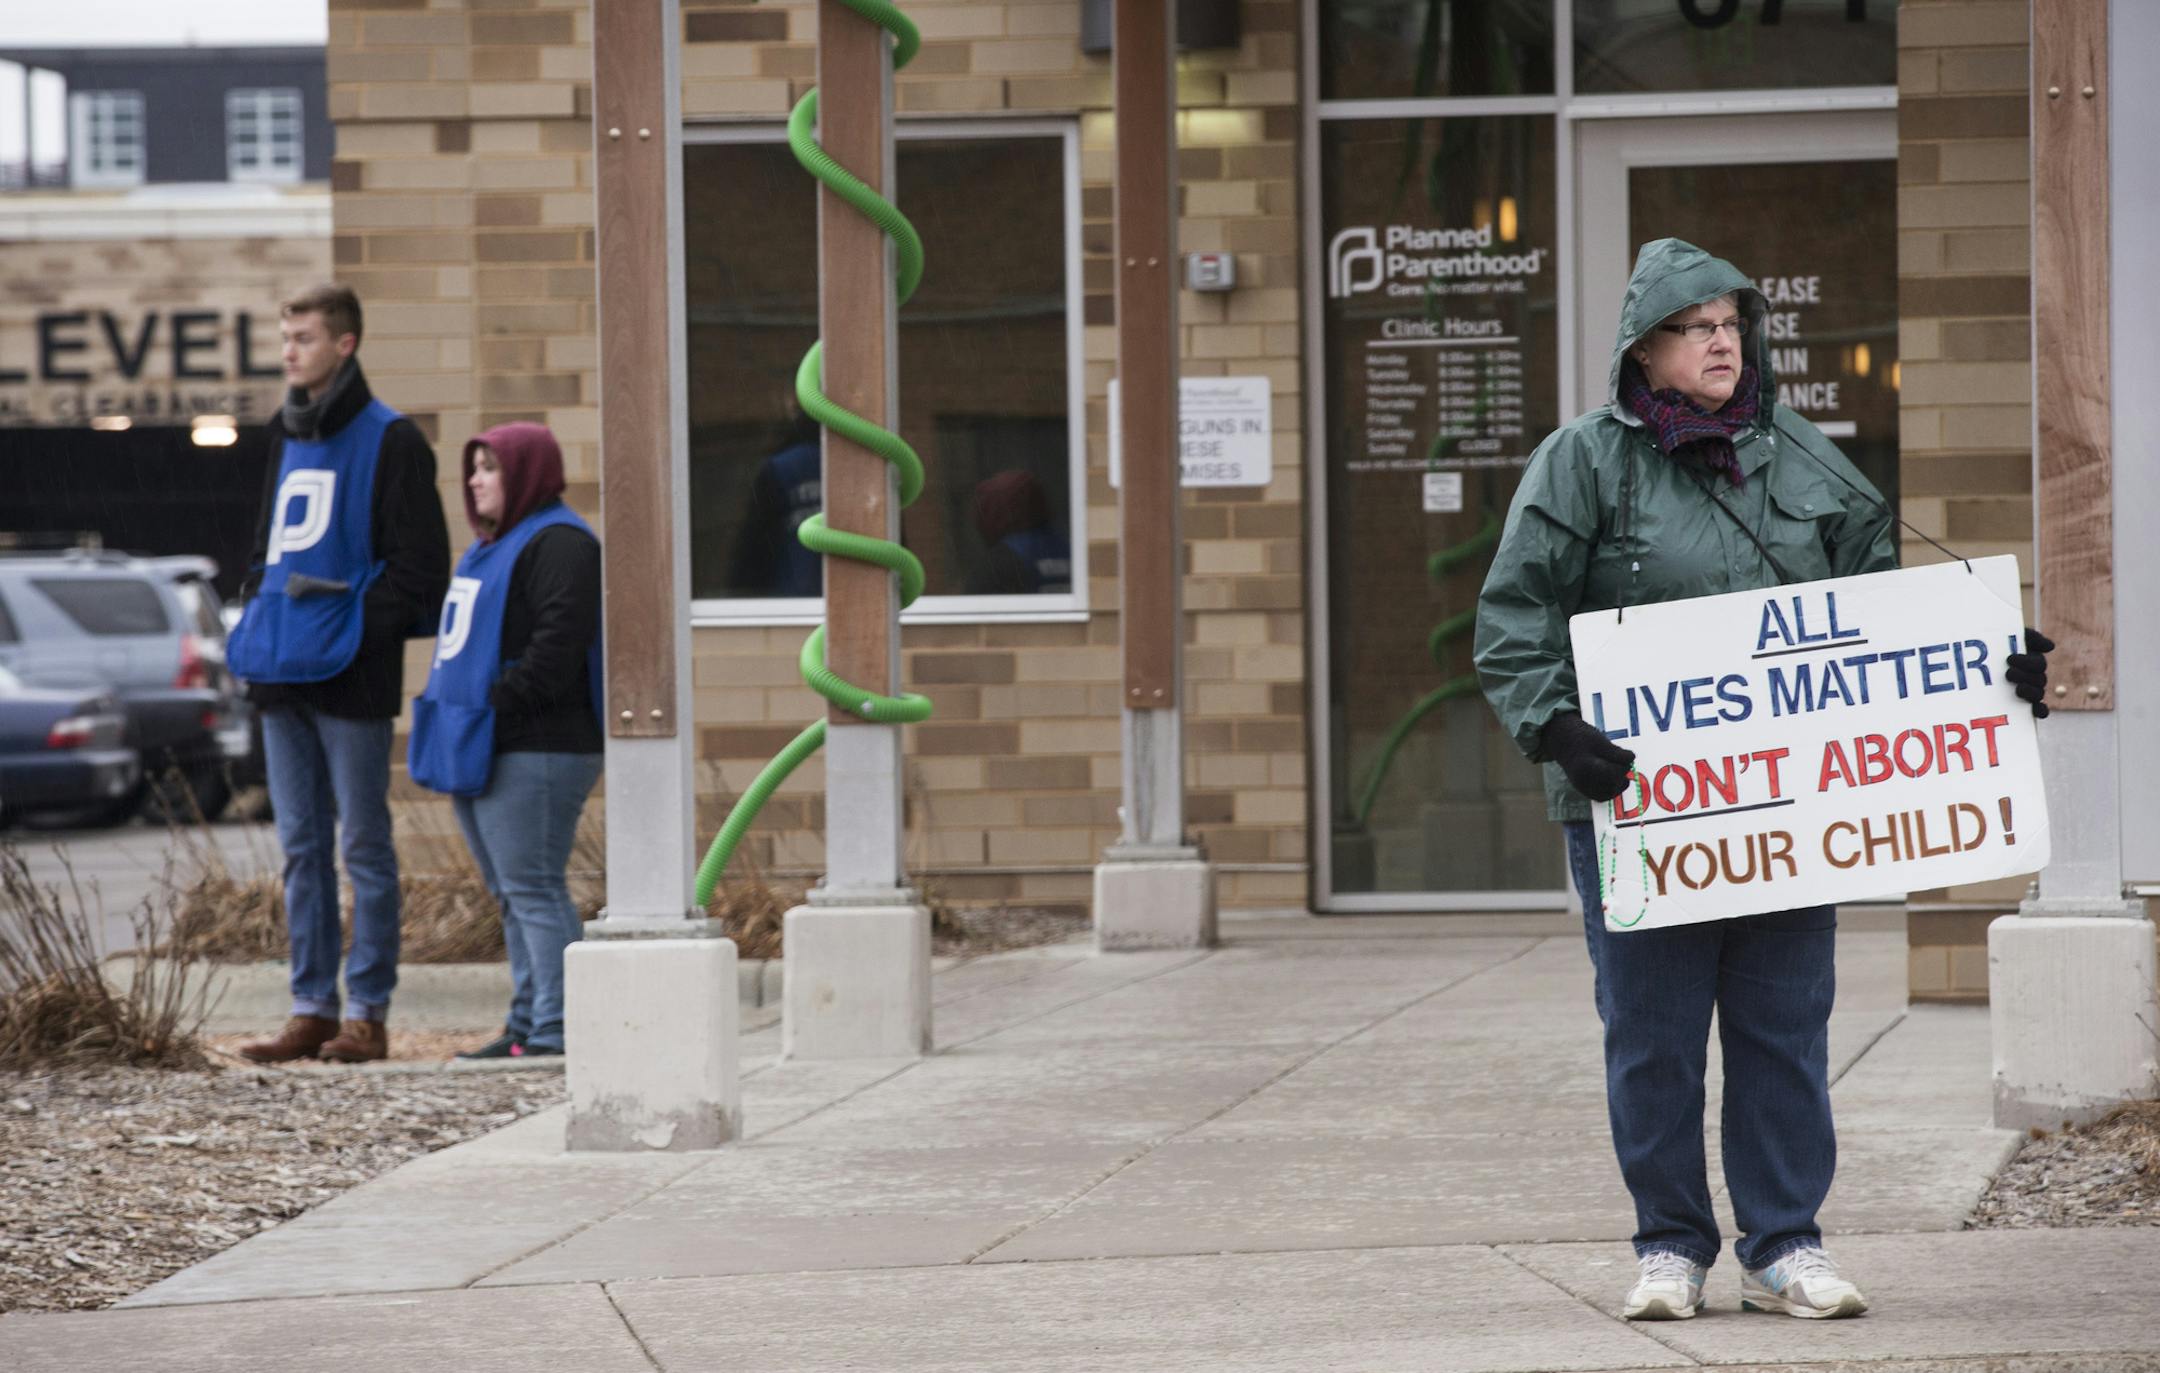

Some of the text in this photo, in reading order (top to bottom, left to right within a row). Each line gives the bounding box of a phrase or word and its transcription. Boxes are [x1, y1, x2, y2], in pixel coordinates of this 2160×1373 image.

[1386, 223, 1492, 249] Planned
[1386, 251, 1541, 278] Parenthood
[1760, 276, 1821, 303] EASE
[1381, 316, 1503, 337] Clinic Hours
[1771, 347, 1809, 374] AIN
[1777, 381, 1840, 410] ANCE
[1181, 440, 1224, 457] ESE
[1756, 592, 1861, 650] ALL
[1593, 674, 1752, 740] LIVES
[1614, 714, 2010, 821] DON'T ABORT
[1638, 830, 1798, 896] YOUR
